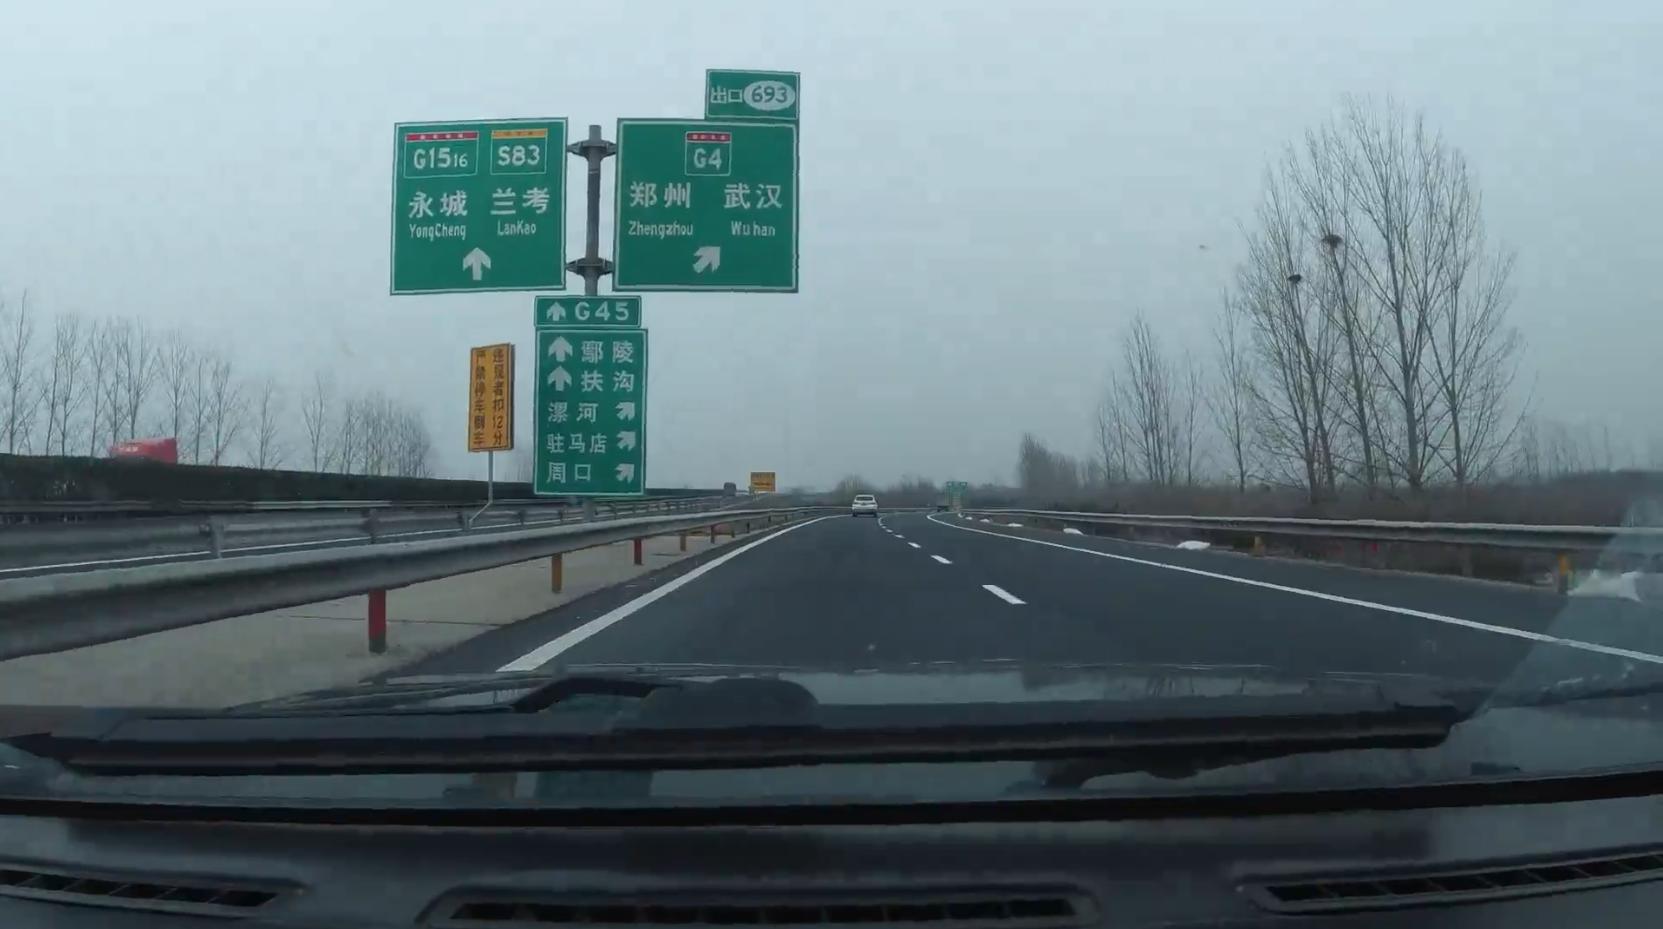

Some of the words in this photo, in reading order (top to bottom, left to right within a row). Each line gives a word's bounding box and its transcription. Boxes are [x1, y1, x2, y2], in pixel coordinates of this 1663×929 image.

[711, 86, 743, 104] 出口
[751, 86, 788, 104] 693
[497, 145, 540, 166] S83
[694, 148, 723, 170] G4
[408, 190, 468, 218] 永城
[490, 187, 550, 214] 兰考
[629, 182, 691, 209] 郑州
[724, 182, 783, 209] 武汉
[409, 223, 466, 242] YongCheng
[497, 220, 537, 236] LanKao
[628, 220, 694, 240] Zhengzhou
[574, 301, 629, 321] G45
[581, 340, 634, 364] 鄢陵
[580, 370, 634, 392] 扶沟
[547, 402, 599, 424] 漯河
[546, 433, 607, 454] 驻马店
[546, 462, 591, 484] 周口
